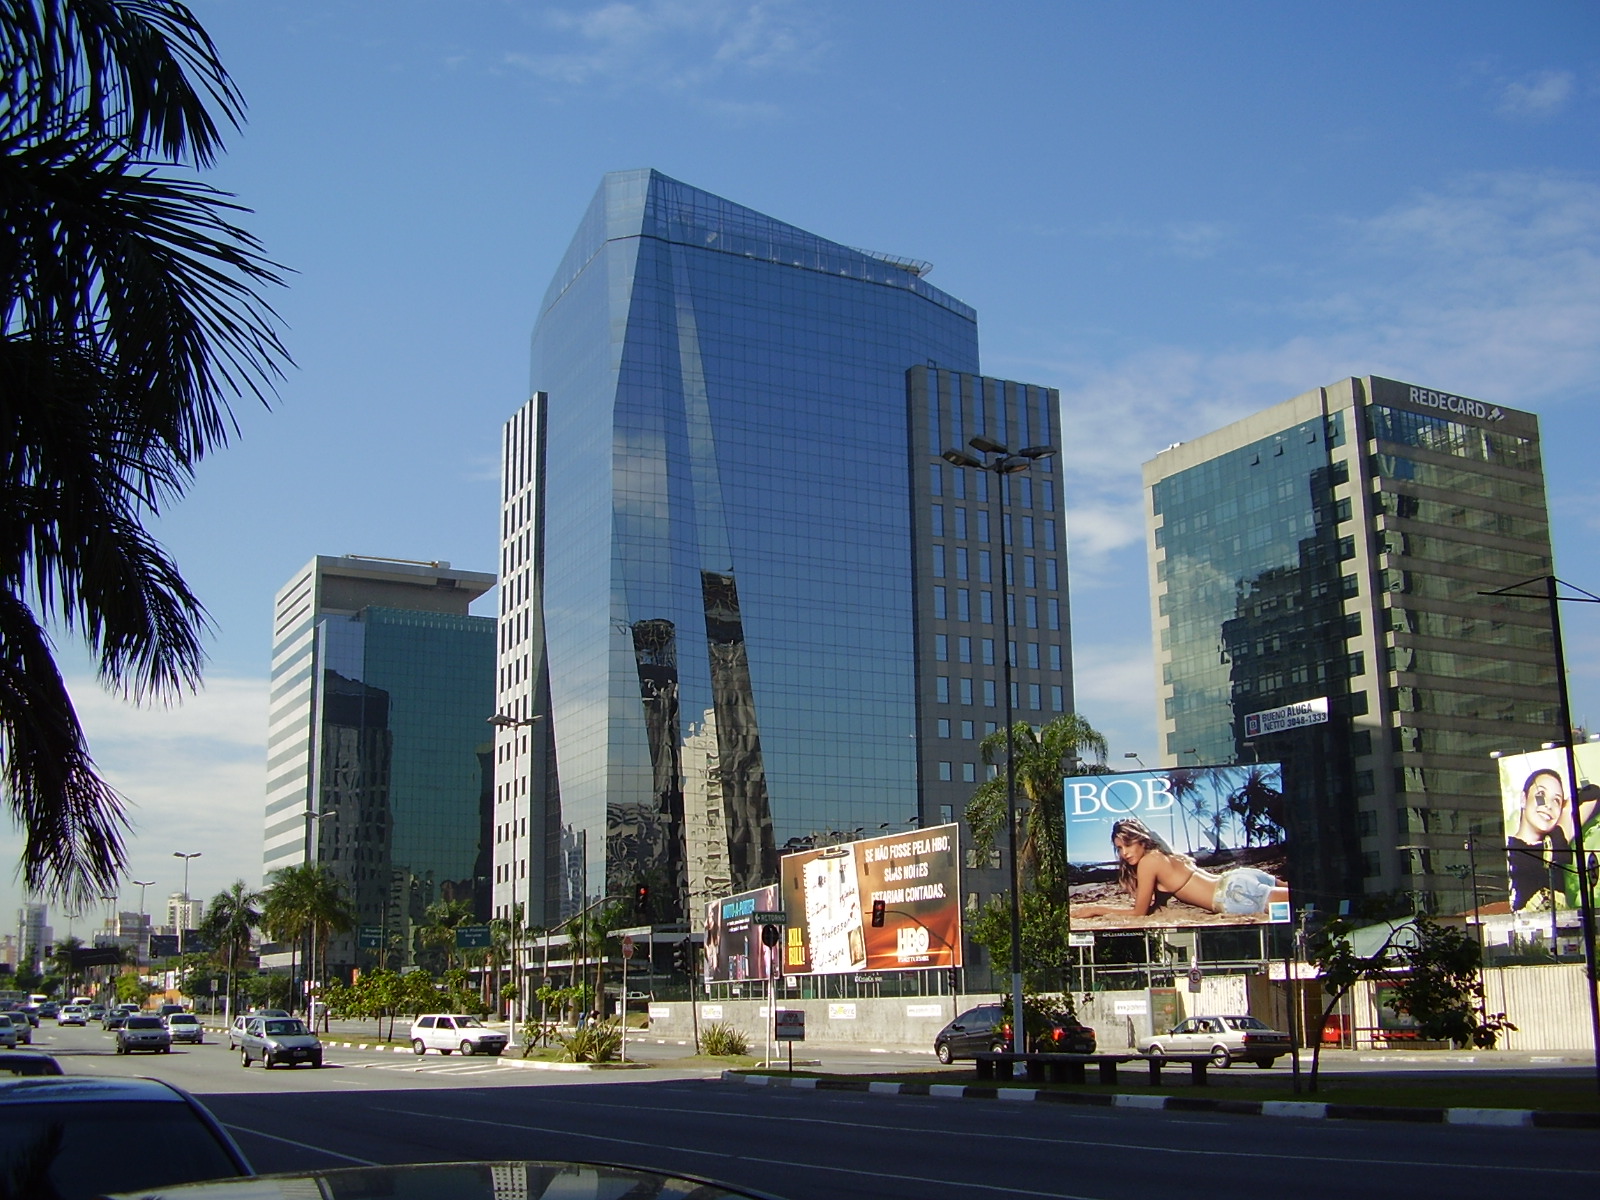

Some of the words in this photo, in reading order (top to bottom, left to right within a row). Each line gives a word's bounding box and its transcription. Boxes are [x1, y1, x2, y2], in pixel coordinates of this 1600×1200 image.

[1409, 386, 1486, 419] REDECARD
[1262, 709, 1286, 723] BUENO
[1287, 703, 1312, 717] ALUGA
[1264, 720, 1285, 731] NETTO
[1068, 778, 1175, 815] BOB
[865, 848, 874, 863] SE
[874, 844, 889, 861] NÃO
[890, 842, 911, 859] FOSSE
[912, 839, 931, 855] PELA
[884, 866, 903, 882] SUAS
[903, 862, 929, 880] NOITES
[905, 883, 947, 902] CONTADAS.
[788, 927, 802, 946] KILL
[897, 926, 929, 954] HBO
